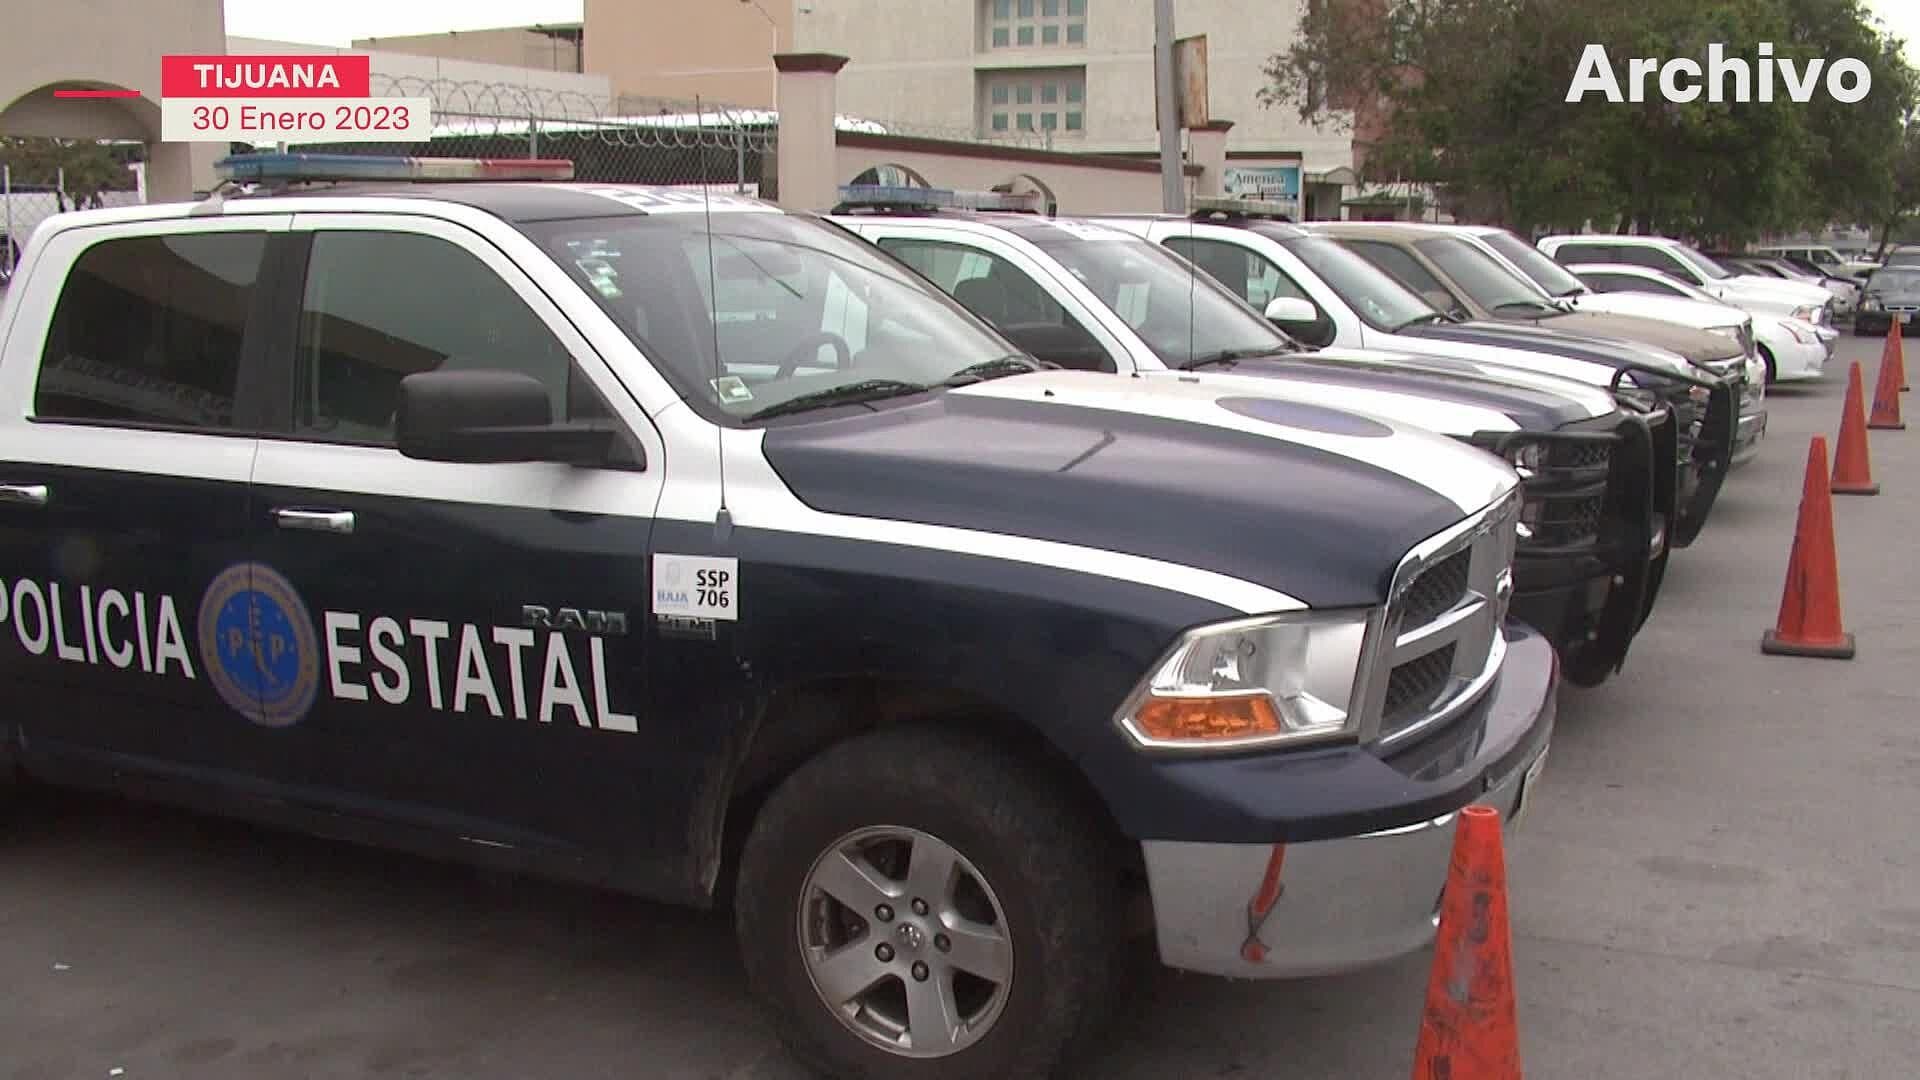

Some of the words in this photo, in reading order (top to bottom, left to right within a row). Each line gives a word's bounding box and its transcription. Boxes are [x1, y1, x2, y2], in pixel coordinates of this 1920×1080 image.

[696, 568, 730, 588] SSP
[696, 588, 730, 609] 706
[522, 604, 627, 634] RAM
[0, 576, 197, 680] OLICIA
[324, 610, 639, 733] ESTATAL
